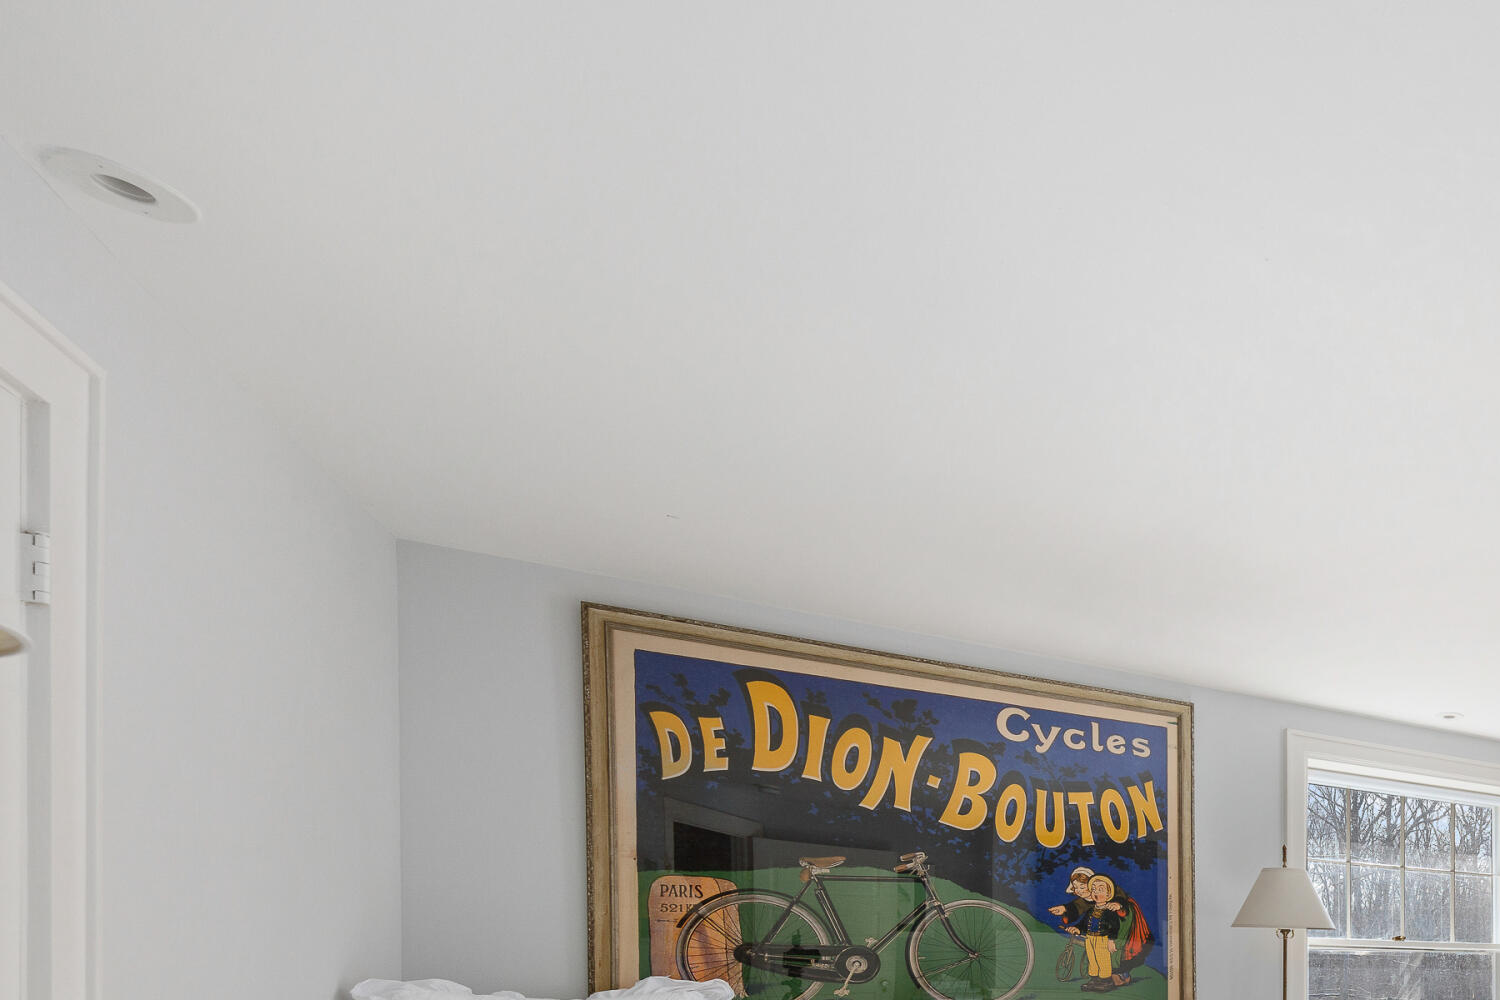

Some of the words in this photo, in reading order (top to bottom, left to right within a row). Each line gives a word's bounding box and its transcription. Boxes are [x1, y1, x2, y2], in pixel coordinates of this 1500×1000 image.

[995, 706, 1151, 757] Cycles
[650, 710, 729, 780] DE
[746, 679, 1164, 849] DION-BOUTON
[660, 884, 704, 898] PARIS
[660, 903, 683, 913] 521
